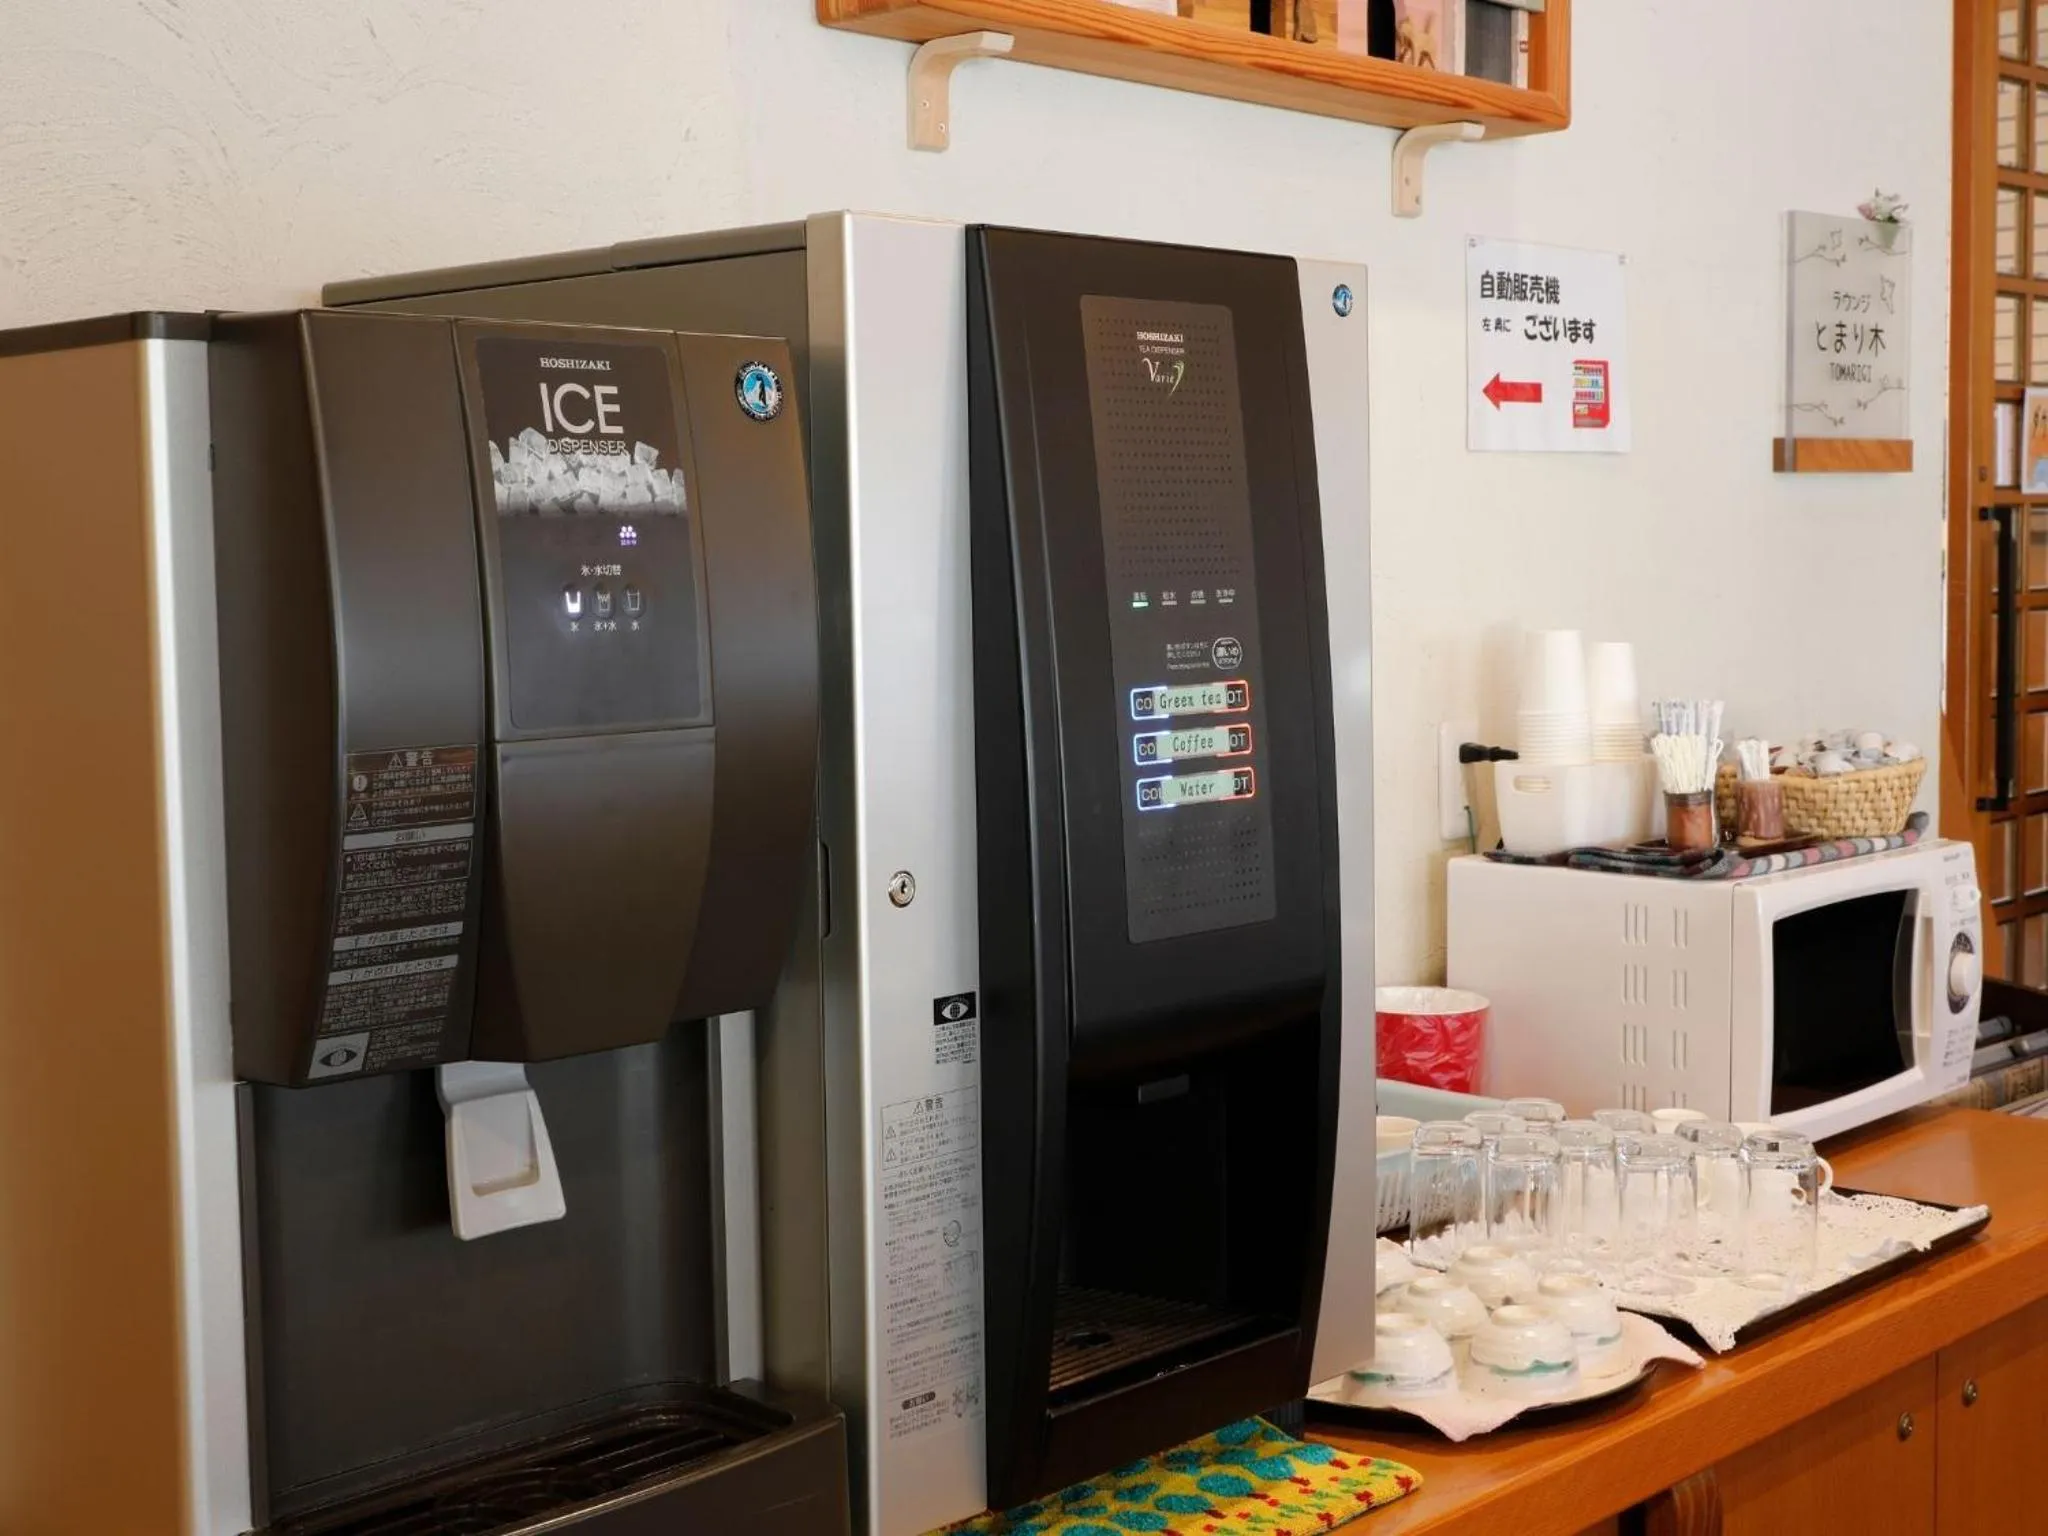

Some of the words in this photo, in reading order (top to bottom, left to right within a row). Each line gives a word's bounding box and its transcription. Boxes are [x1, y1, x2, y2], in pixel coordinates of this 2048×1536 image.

[1480, 269, 1560, 305] 自動販売機
[1833, 291, 1871, 313] ラウンジ
[1136, 331, 1184, 343] HOSHIZAKI
[1523, 315, 1596, 344] ございます
[1816, 320, 1886, 357] とまり木
[539, 357, 612, 371] HOSHIZAKI
[1829, 362, 1872, 383] TOMARIGI
[539, 382, 624, 434] ICE
[548, 438, 628, 455] DISPENSER
[1159, 692, 1195, 710] Green
[1202, 691, 1222, 707] tea
[1173, 735, 1214, 753] Coffee
[1180, 780, 1215, 797] Water
